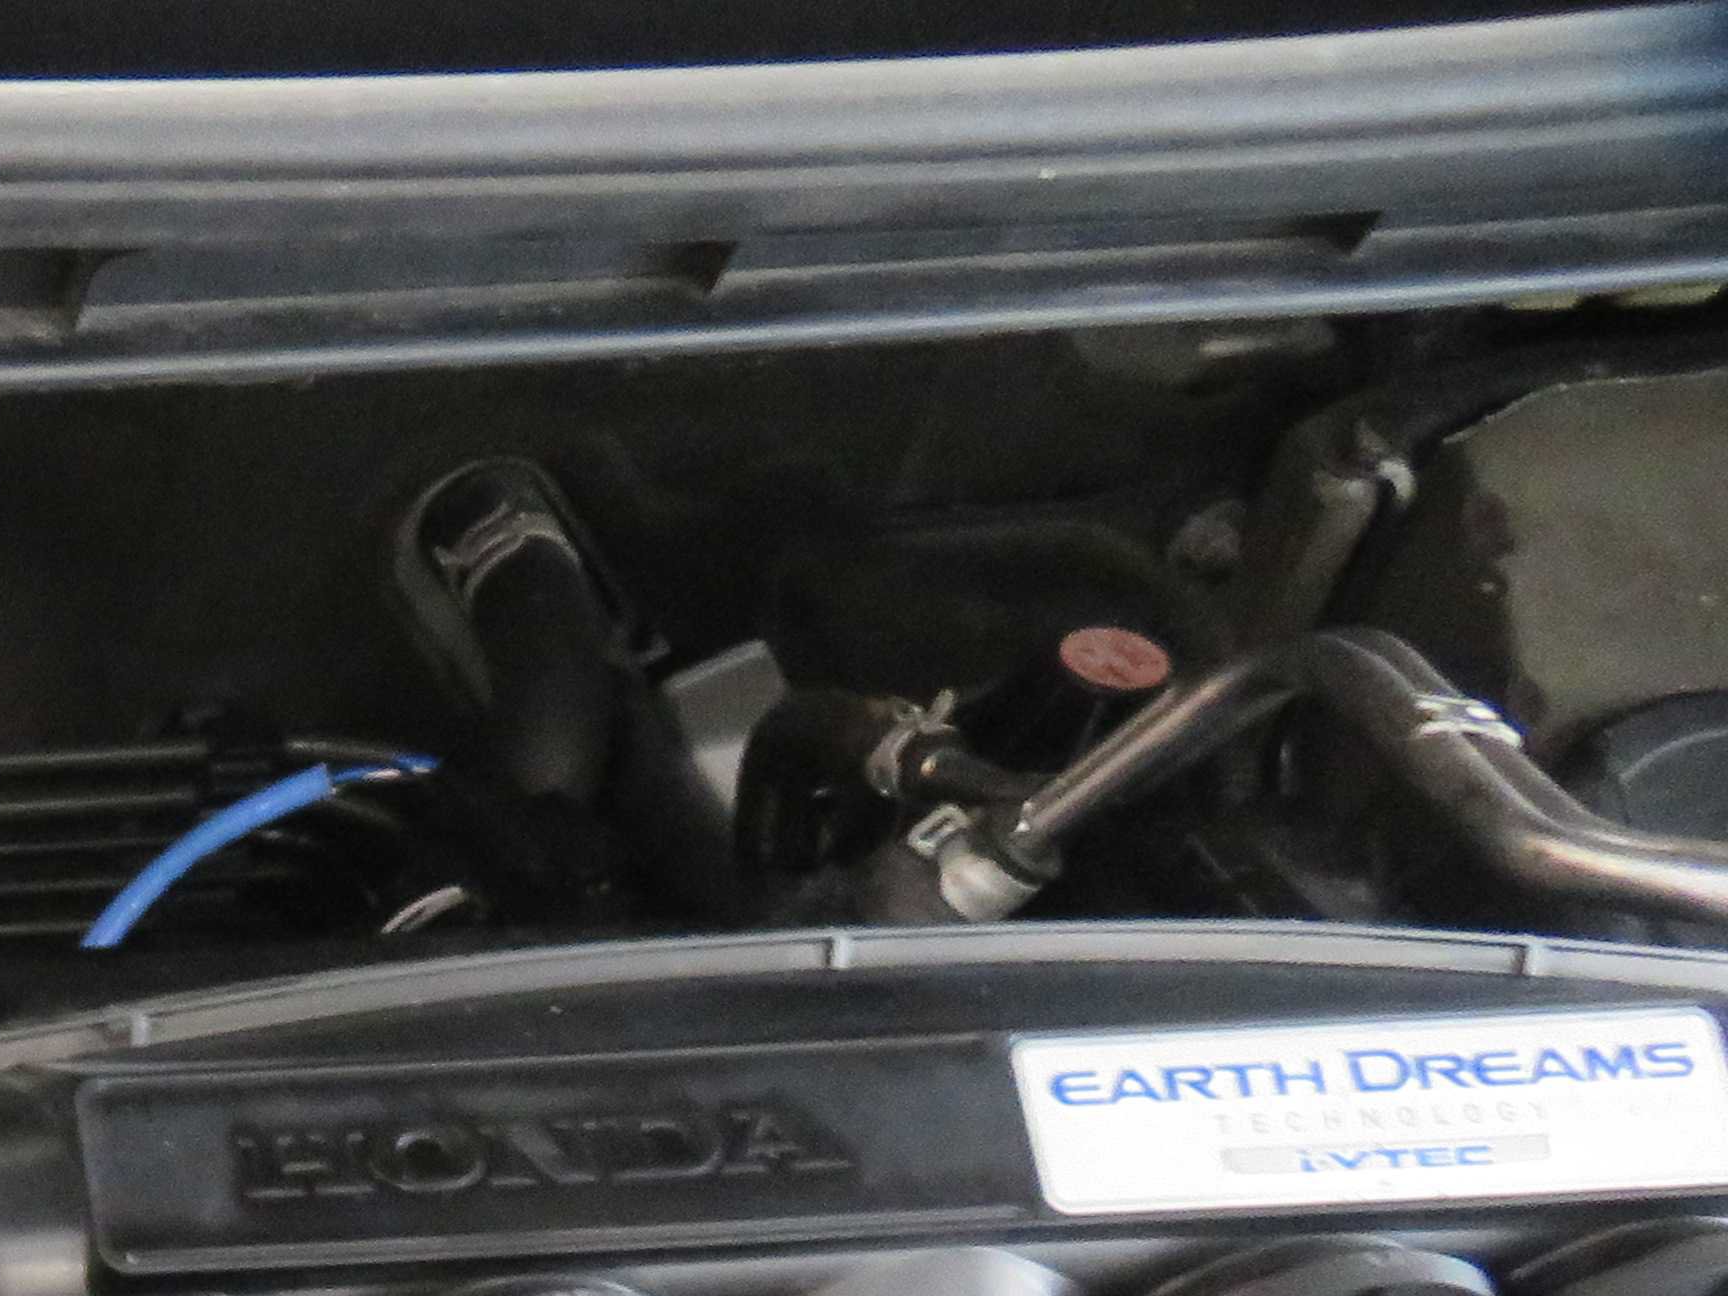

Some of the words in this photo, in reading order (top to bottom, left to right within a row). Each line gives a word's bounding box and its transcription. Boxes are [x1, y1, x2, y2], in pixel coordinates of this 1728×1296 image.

[1050, 1058, 1327, 1106] EARTH
[1345, 1042, 1695, 1093] DREAMS
[1213, 1100, 1550, 1136] TECHNOLOGY
[231, 1104, 856, 1199] HONDA
